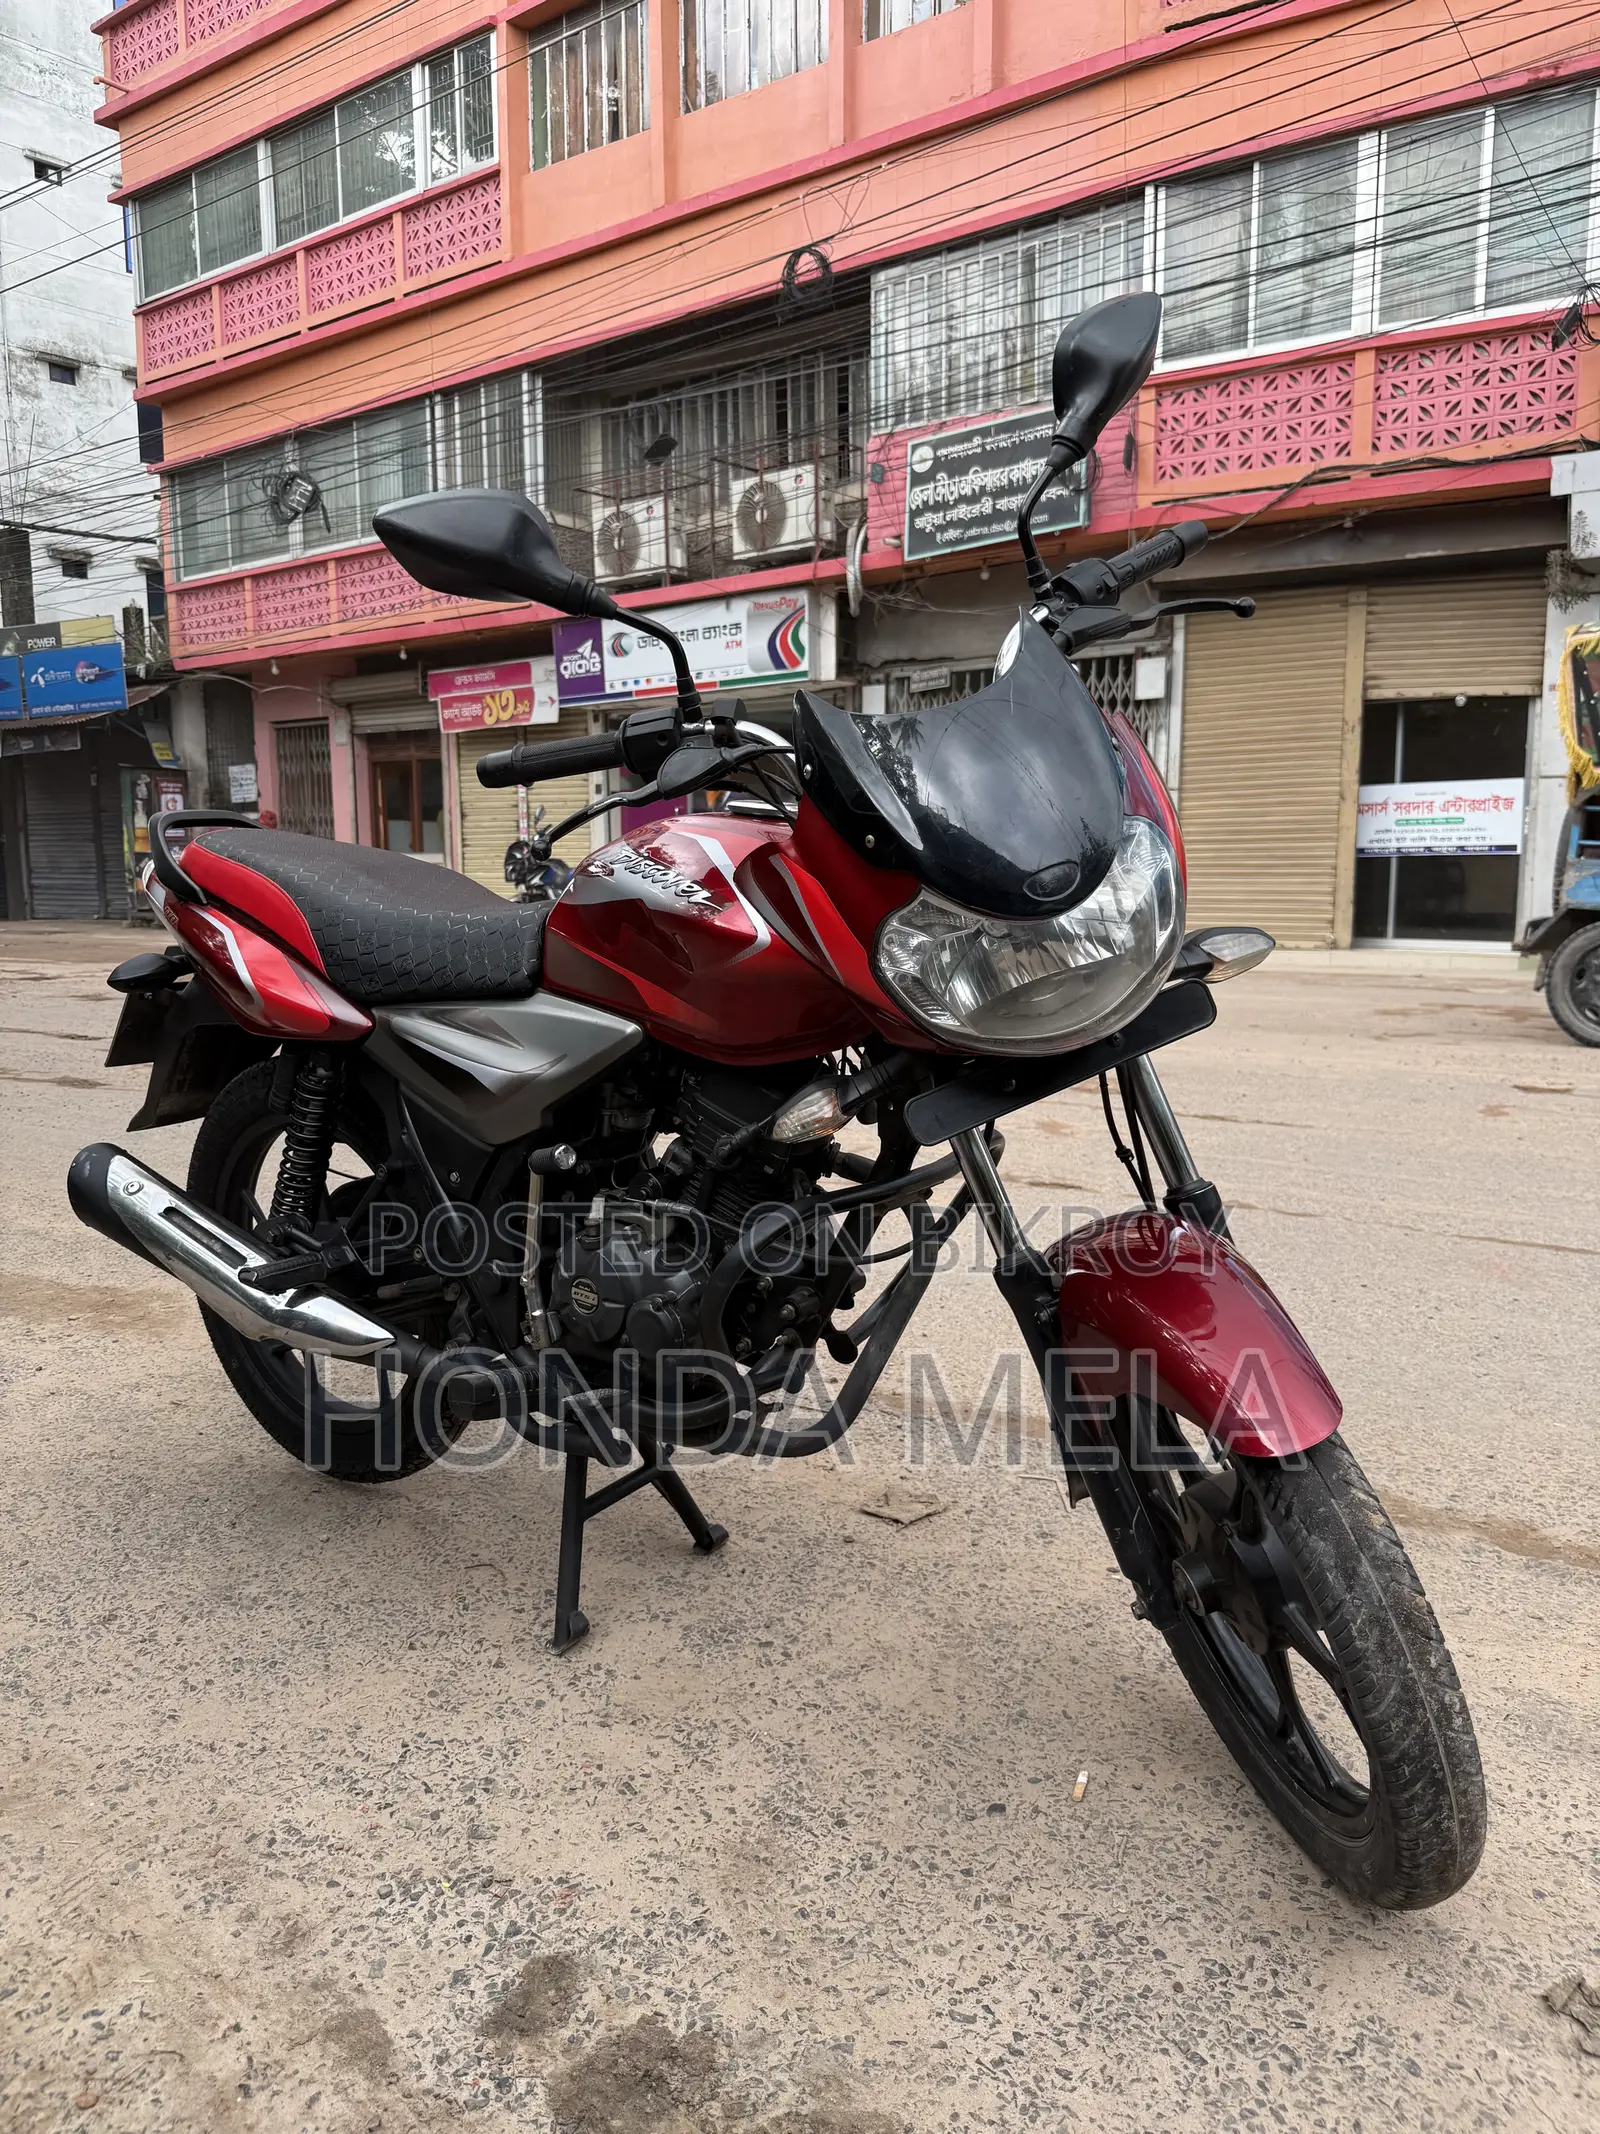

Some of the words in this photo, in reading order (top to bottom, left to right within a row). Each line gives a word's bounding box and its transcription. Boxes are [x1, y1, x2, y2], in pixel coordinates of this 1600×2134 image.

[910, 483, 934, 510] জেলা
[934, 473, 958, 505] ক্রীড়া
[702, 622, 742, 640] ব্যাংক
[27, 637, 56, 649] POWER
[725, 640, 742, 649] ATM
[560, 652, 601, 679] রকেট
[1394, 800, 1434, 816] সরদার
[1439, 794, 1515, 816] এন্টারপ্রাইজ
